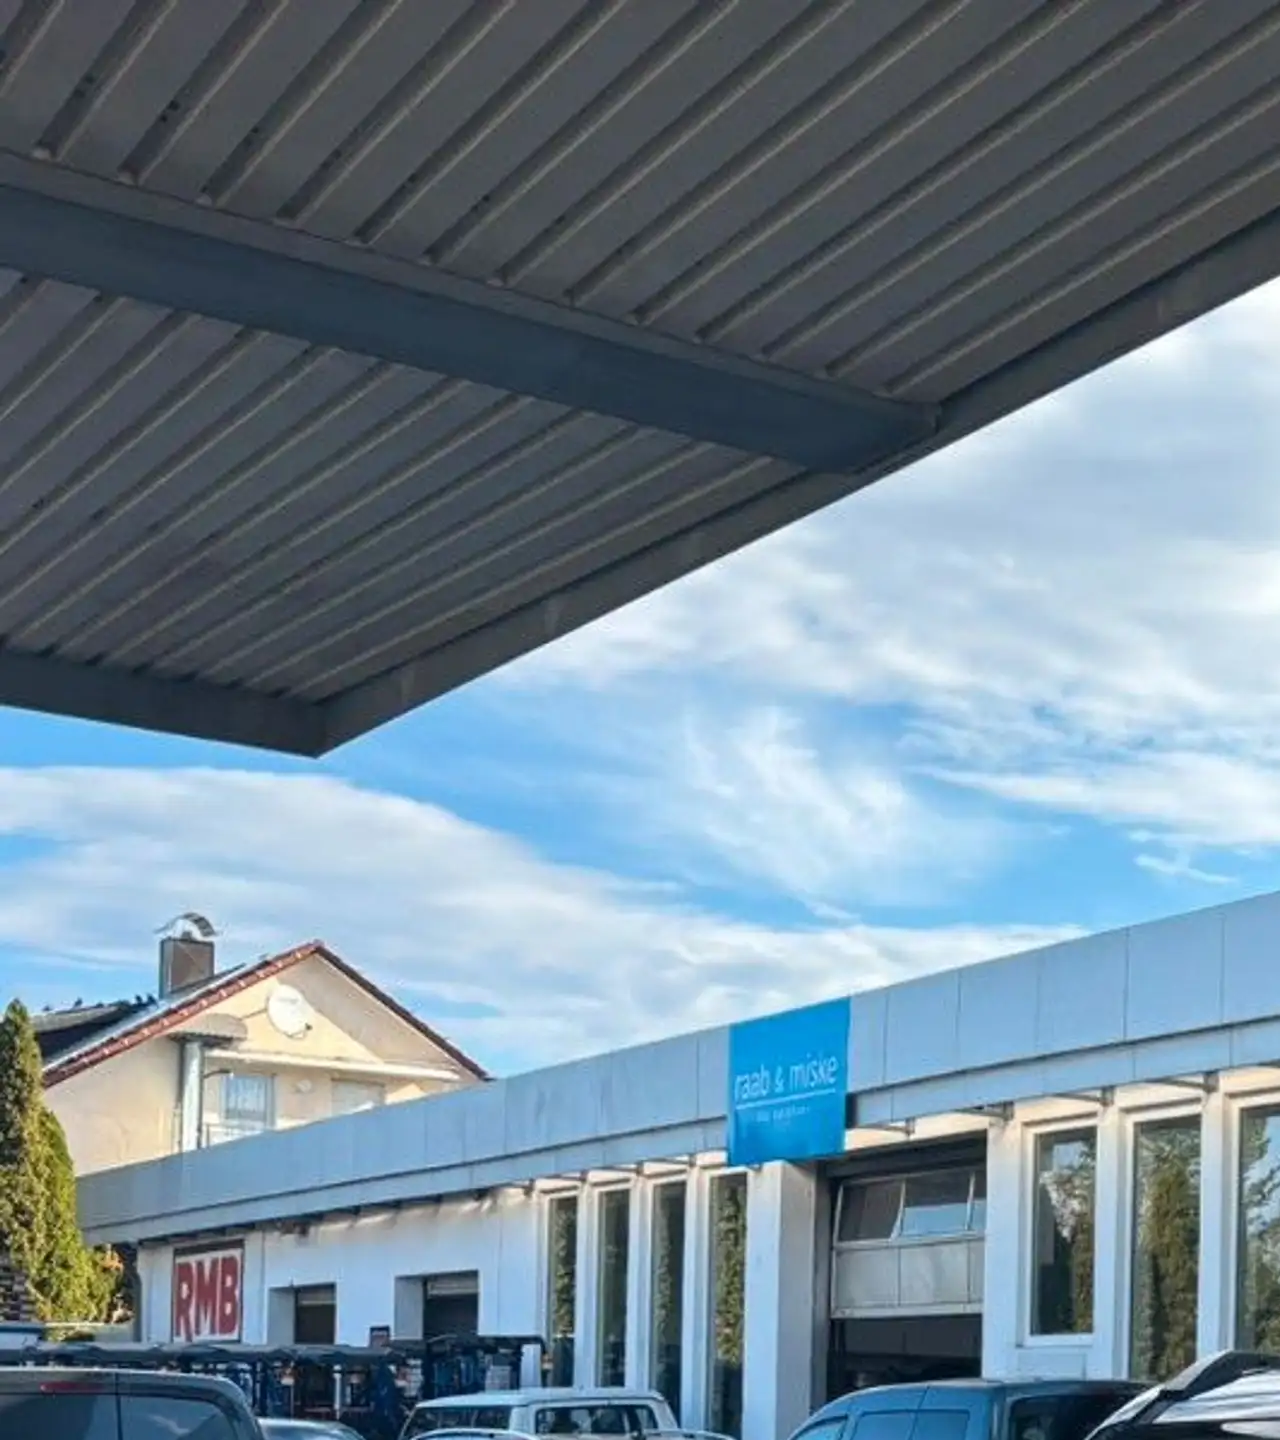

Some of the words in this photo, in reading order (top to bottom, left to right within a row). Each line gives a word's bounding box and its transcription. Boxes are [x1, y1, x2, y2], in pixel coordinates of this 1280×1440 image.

[734, 1063, 770, 1101] raab
[775, 1066, 784, 1094] &
[789, 1051, 839, 1092] miske
[175, 1255, 239, 1342] RMB
